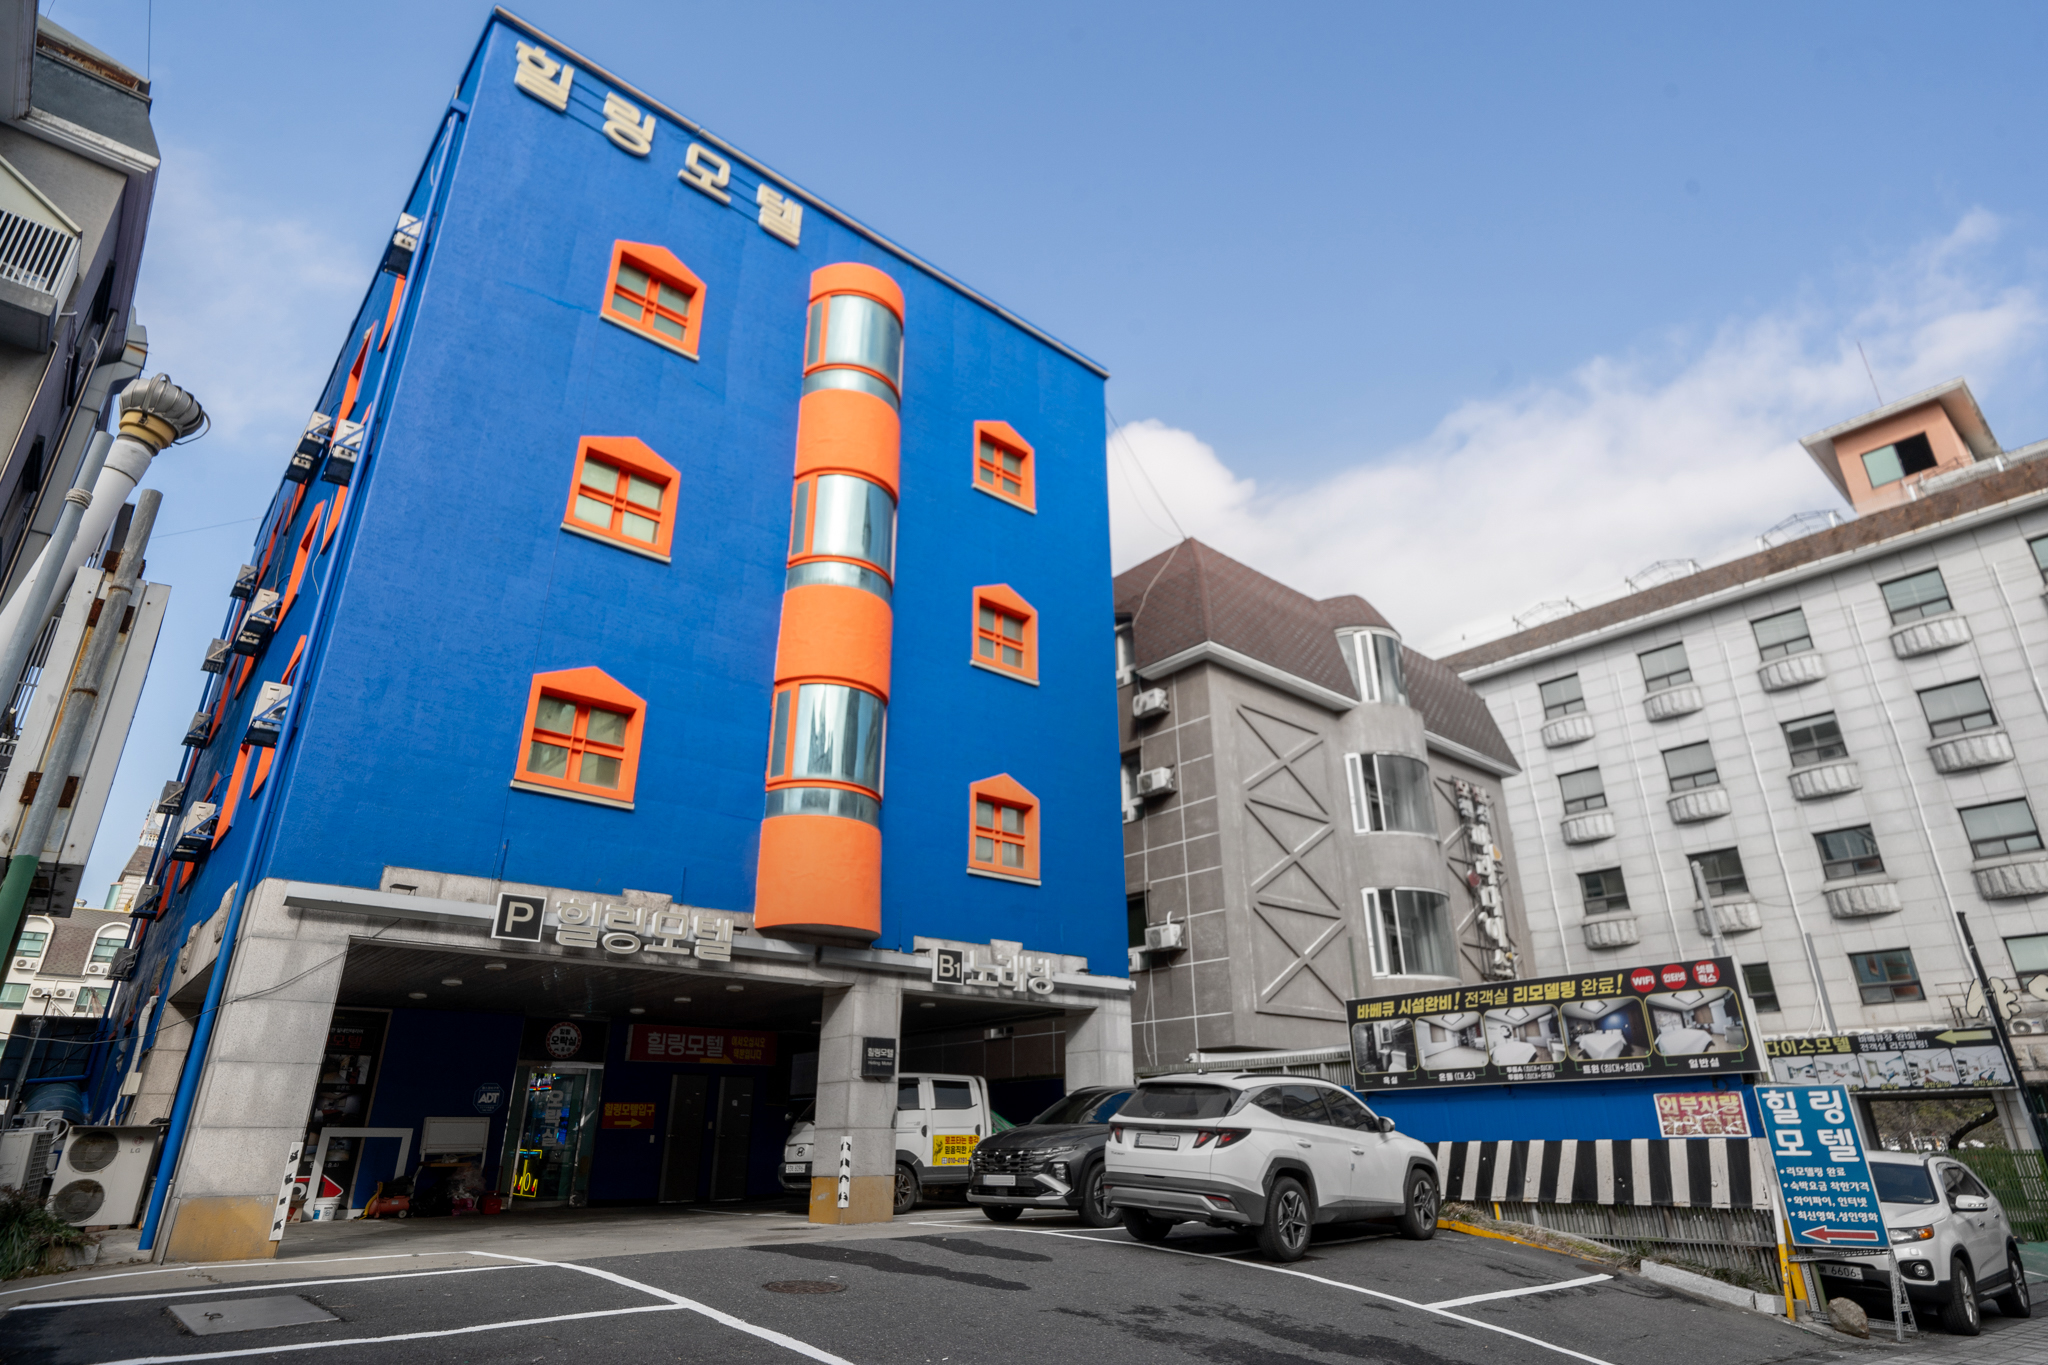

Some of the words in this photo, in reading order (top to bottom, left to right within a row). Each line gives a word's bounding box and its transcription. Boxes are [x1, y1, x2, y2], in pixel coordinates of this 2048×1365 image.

[505, 901, 535, 932] P
[556, 898, 734, 962] 힐링모텔
[938, 954, 961, 979] B1
[966, 950, 1055, 994] 노래방
[1632, 975, 1655, 986] WIFI
[1663, 972, 1686, 983] 인터넷
[1357, 1001, 1395, 1019] 바베큐
[1398, 991, 1460, 1015] 시설완비!
[1464, 988, 1508, 1008] 전객실
[1513, 981, 1576, 1003] 리모델링
[1581, 973, 1623, 997] 완료!
[327, 1034, 363, 1049] 모텔
[551, 1036, 577, 1046] 오락실
[647, 1032, 724, 1057] 힐링모텔
[732, 1036, 766, 1048] 어서오십시오
[1764, 1036, 1852, 1056] 다이스모텔
[1860, 1042, 1887, 1052] 전객실
[1889, 1039, 1929, 1050] 리모델링!
[868, 1047, 894, 1058] 힐링모텔
[1688, 1058, 1720, 1069] 일반실
[478, 1092, 500, 1104] ADT
[604, 1103, 655, 1117] 힐링모텔입구
[1659, 1095, 1741, 1115] 외부차량
[1786, 1167, 1823, 1177] 리모델링
[1826, 1167, 1846, 1177] 완료
[1790, 1181, 1828, 1192] 숙박요금
[1830, 1181, 1870, 1192] 착한가격
[1793, 1196, 1836, 1207] 와이파이,
[1837, 1197, 1868, 1207] 인터넷
[1831, 1266, 1857, 1278] 6606
